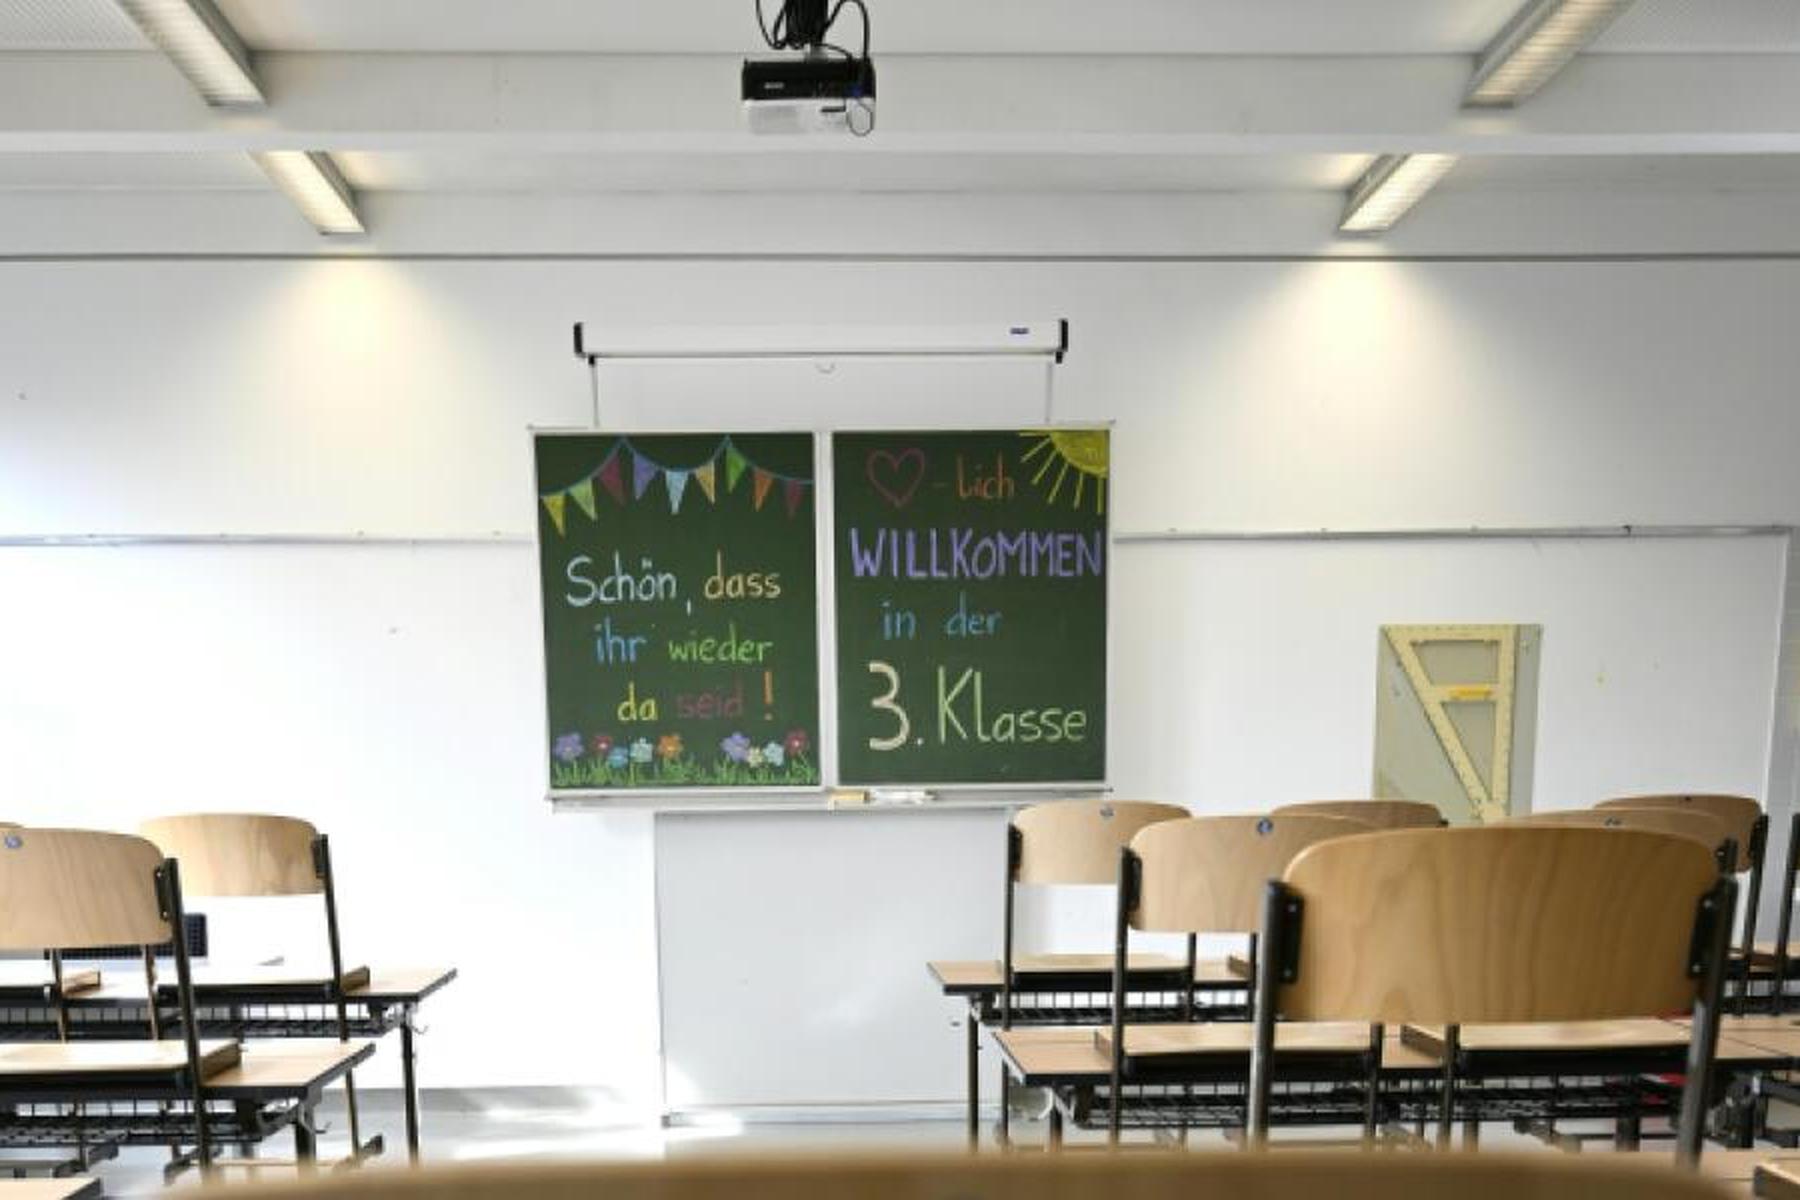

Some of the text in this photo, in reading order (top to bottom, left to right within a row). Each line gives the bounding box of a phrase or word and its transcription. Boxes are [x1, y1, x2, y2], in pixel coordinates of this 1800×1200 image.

[704, 549, 782, 599] dass
[850, 527, 1101, 579] WILLKOMMEN
[594, 616, 773, 664] ihr wieder
[880, 591, 1001, 640] in der
[617, 681, 658, 721] da
[869, 660, 1087, 750] 3. Klasse
